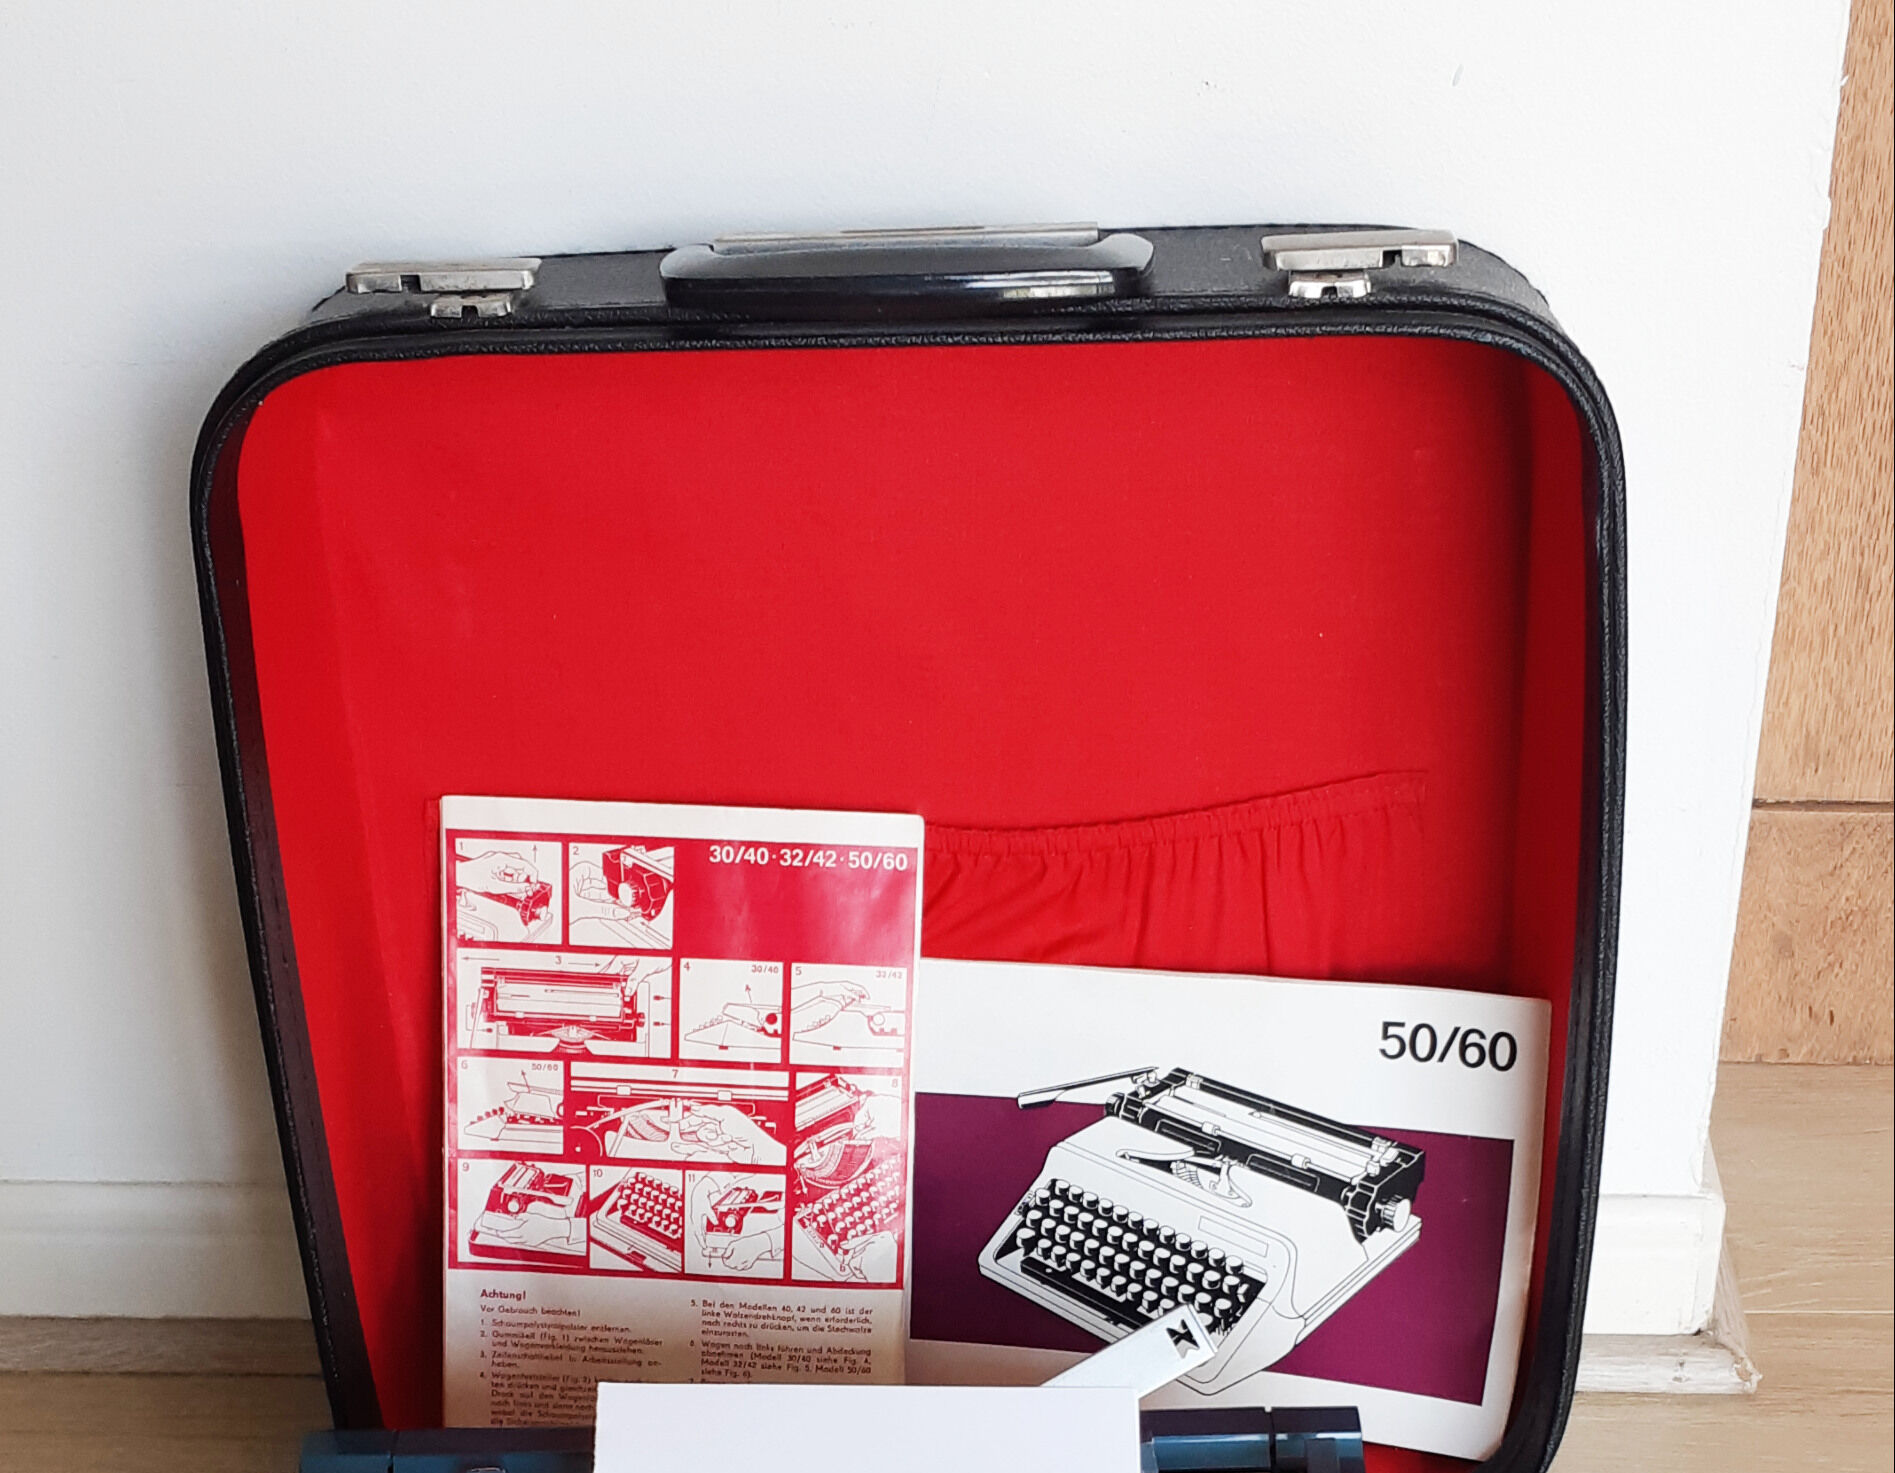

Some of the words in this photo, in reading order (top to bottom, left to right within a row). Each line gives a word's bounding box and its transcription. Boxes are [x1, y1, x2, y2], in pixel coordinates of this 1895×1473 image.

[572, 846, 580, 856] 2
[709, 845, 769, 865] 30/40
[779, 848, 837, 868] 32/42
[848, 851, 908, 871] 50/60
[555, 955, 562, 965] 3
[683, 961, 691, 971] 4
[751, 964, 779, 974] 30/40
[795, 966, 802, 976] 5
[1379, 1021, 1517, 1072] 50/60
[672, 1069, 679, 1078] 7
[462, 1162, 470, 1172] 9
[593, 1168, 603, 1178] 10
[688, 1171, 696, 1183] 11
[480, 1289, 527, 1301] Achtung!
[480, 1304, 495, 1313] Vor
[498, 1305, 538, 1315] Gebrauch
[541, 1307, 581, 1317] beachten!
[702, 1300, 716, 1308] Bei
[719, 1301, 734, 1309] den
[739, 1303, 777, 1312] Modellen
[796, 1305, 806, 1313] 42
[859, 1307, 873, 1315] der
